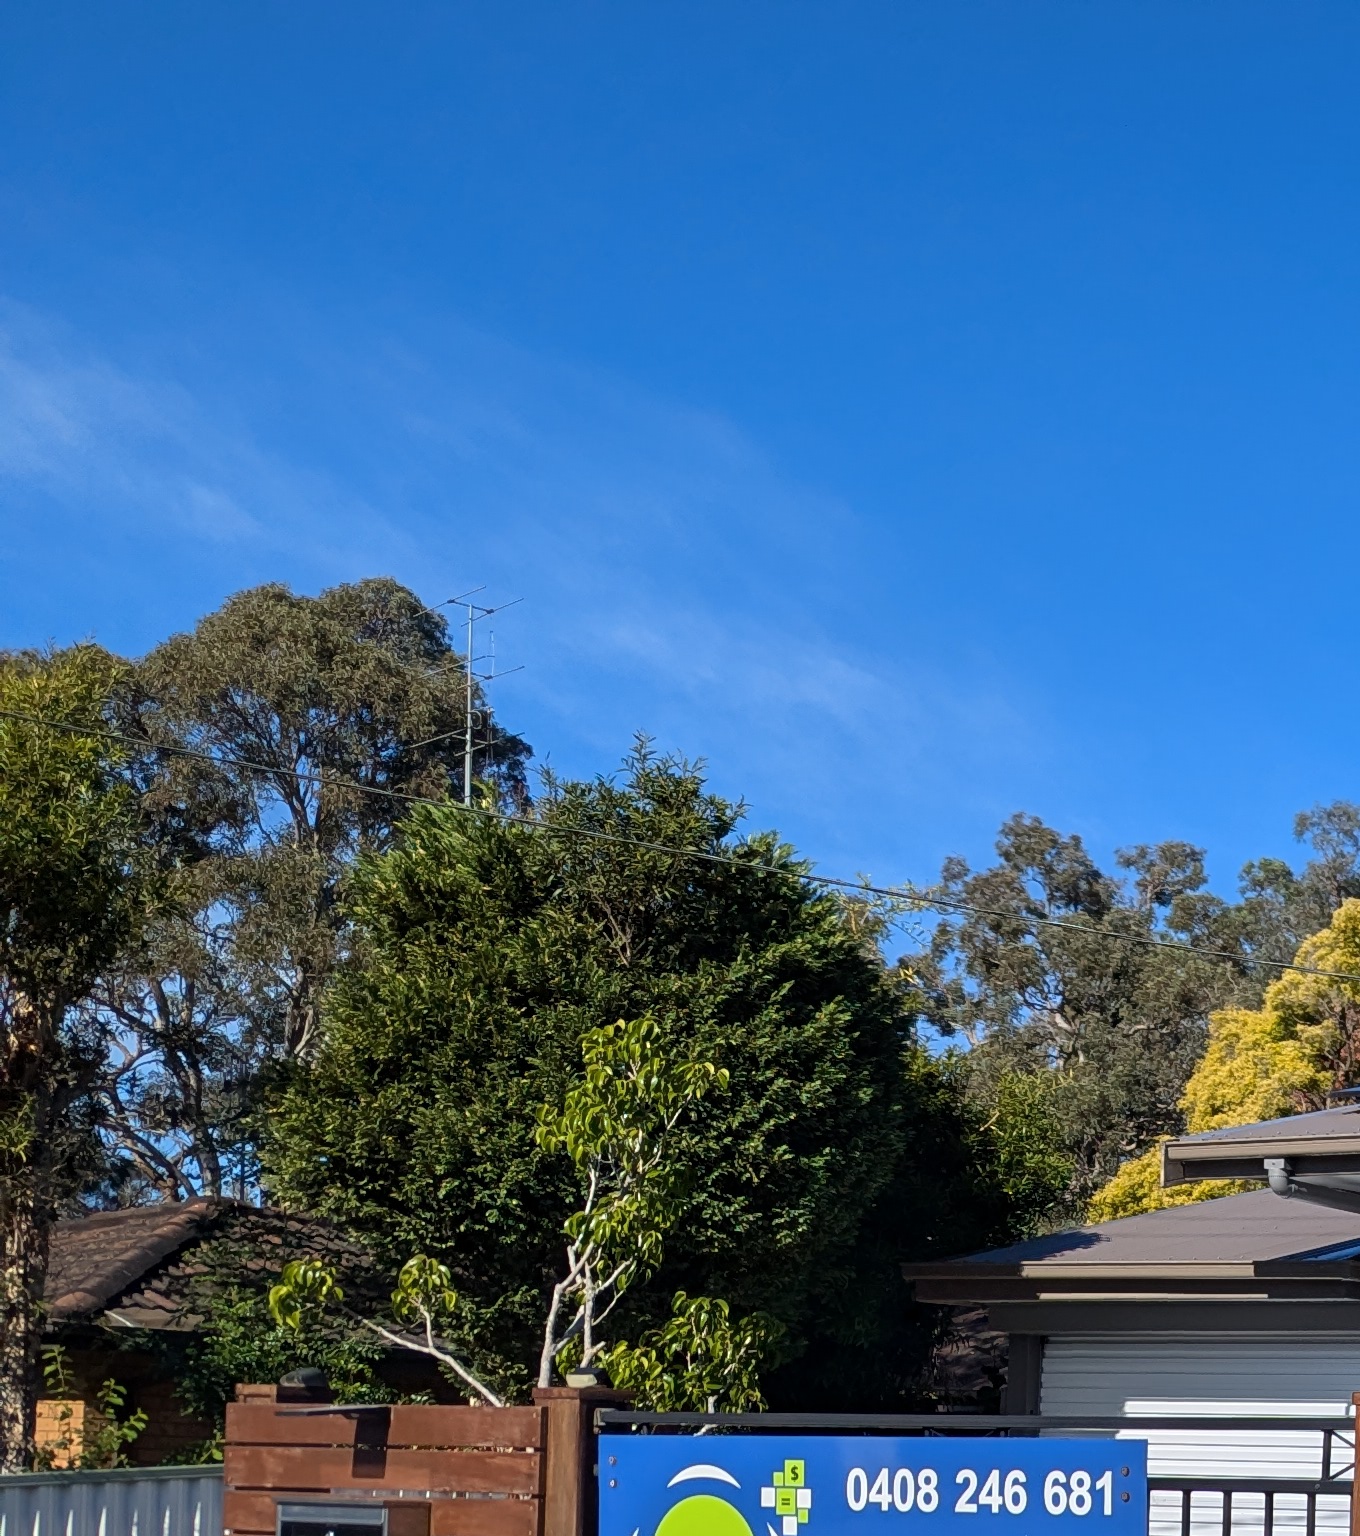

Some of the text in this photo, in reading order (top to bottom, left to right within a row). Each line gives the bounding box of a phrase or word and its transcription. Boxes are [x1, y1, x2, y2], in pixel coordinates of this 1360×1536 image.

[846, 1467, 1113, 1516] 0408 246 681
